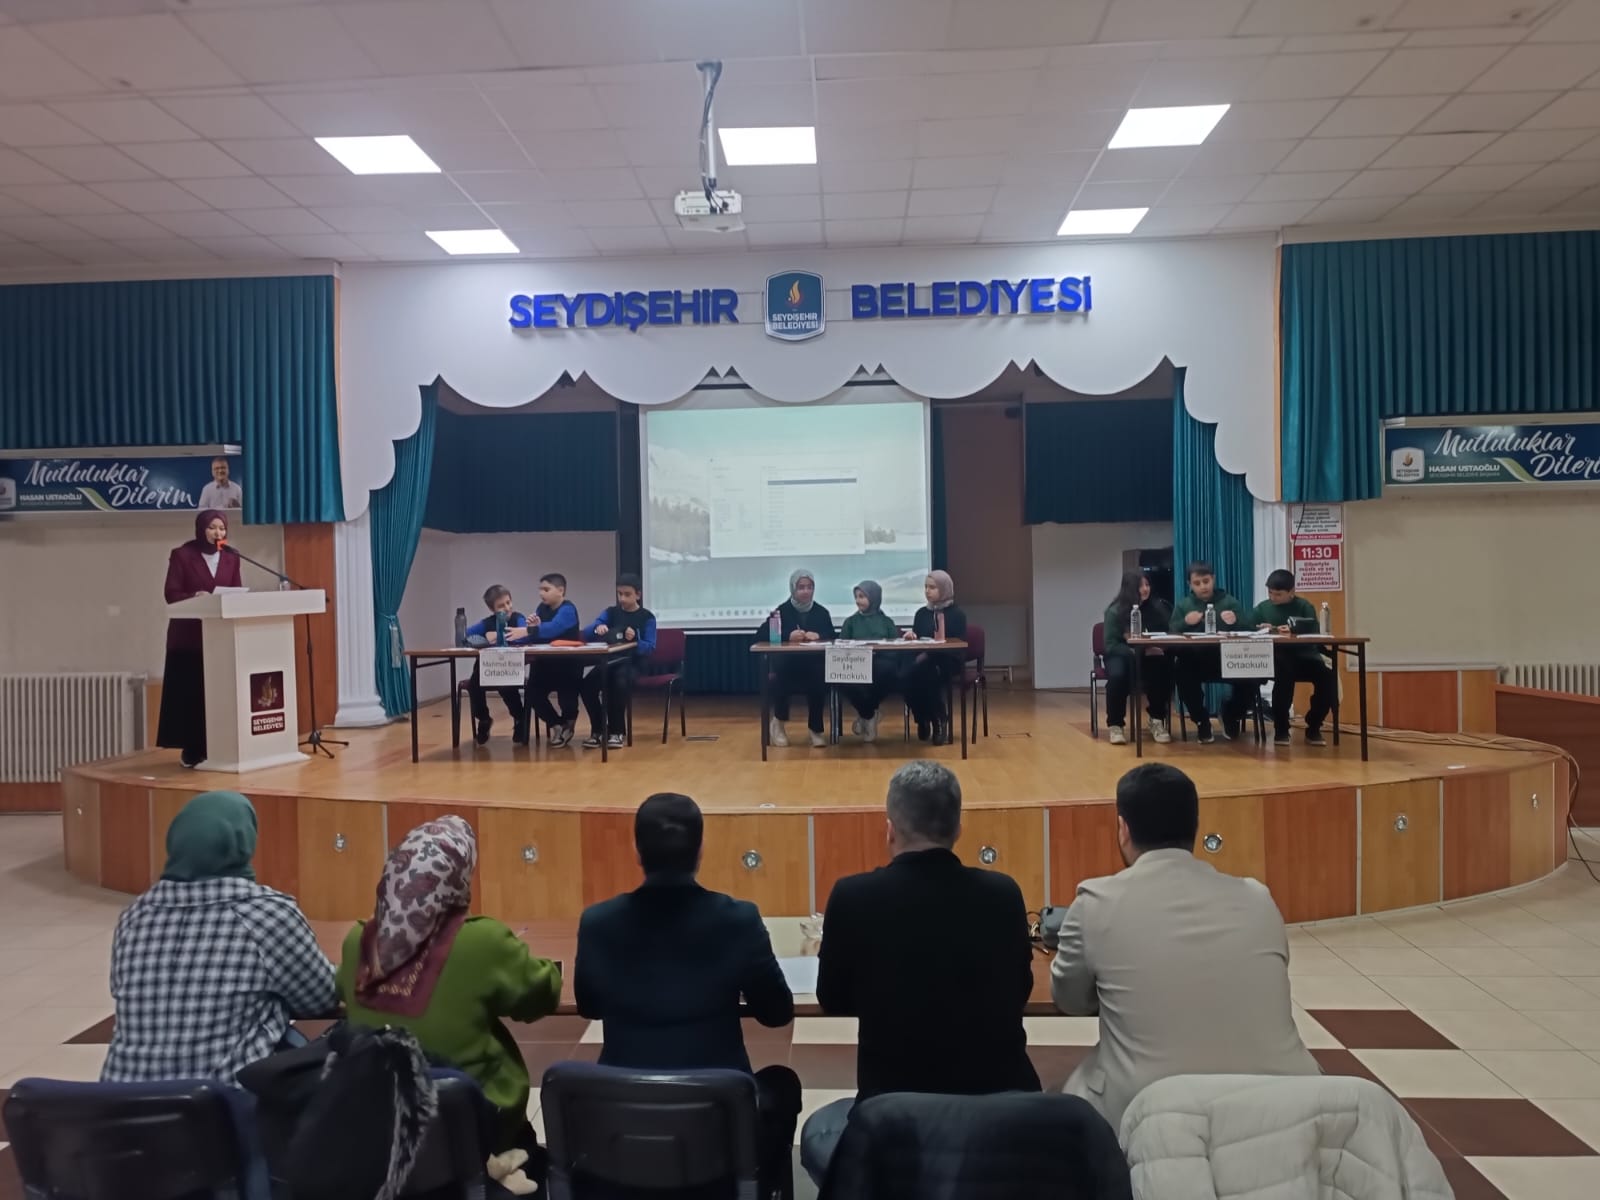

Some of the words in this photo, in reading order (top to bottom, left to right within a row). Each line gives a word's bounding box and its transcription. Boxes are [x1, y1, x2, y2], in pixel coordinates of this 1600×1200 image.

[1433, 429, 1576, 457] Mutluluklar
[24, 460, 150, 487] Mutluluklar
[1429, 465, 1457, 473] HASAN
[1458, 463, 1500, 472] USTAOĞLU
[108, 483, 200, 509] Dilerim
[1301, 546, 1332, 559] 11:30
[1227, 661, 1268, 669] Ortaokulu
[484, 669, 520, 677] Ortaokulu
[830, 672, 868, 680] Ortaokulu
